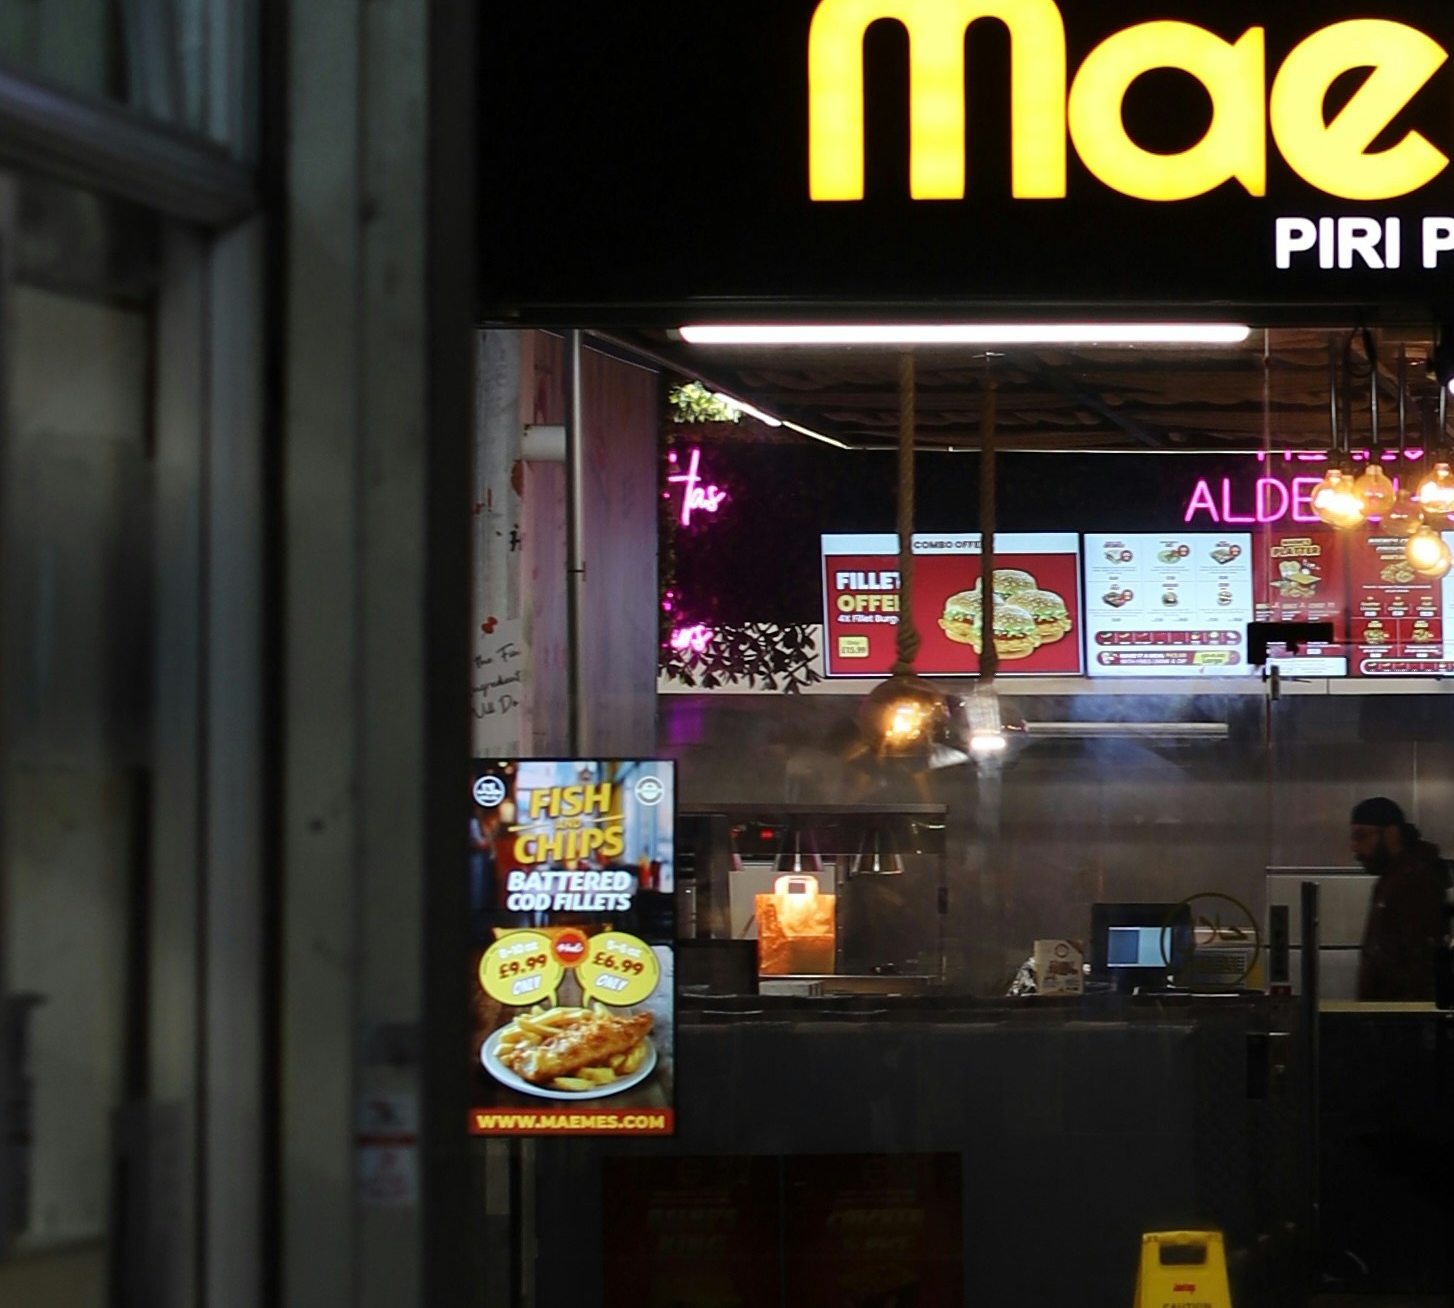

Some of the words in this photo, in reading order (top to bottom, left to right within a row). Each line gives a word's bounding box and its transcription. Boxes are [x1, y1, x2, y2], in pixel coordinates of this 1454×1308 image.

[1275, 216, 1401, 270] PIRI
[913, 540, 953, 549] COMBO
[955, 540, 982, 549] OFFE
[1272, 546, 1318, 556] PLATTER
[528, 781, 612, 820] FISH
[513, 825, 626, 865] CHIPS
[506, 870, 632, 892] BATTERED
[506, 893, 552, 912] COD
[552, 893, 632, 912] FILLETS
[499, 953, 547, 979] £9.99
[593, 951, 645, 976] £6.99
[476, 1114, 665, 1130] WWW.MAEMES.COM
